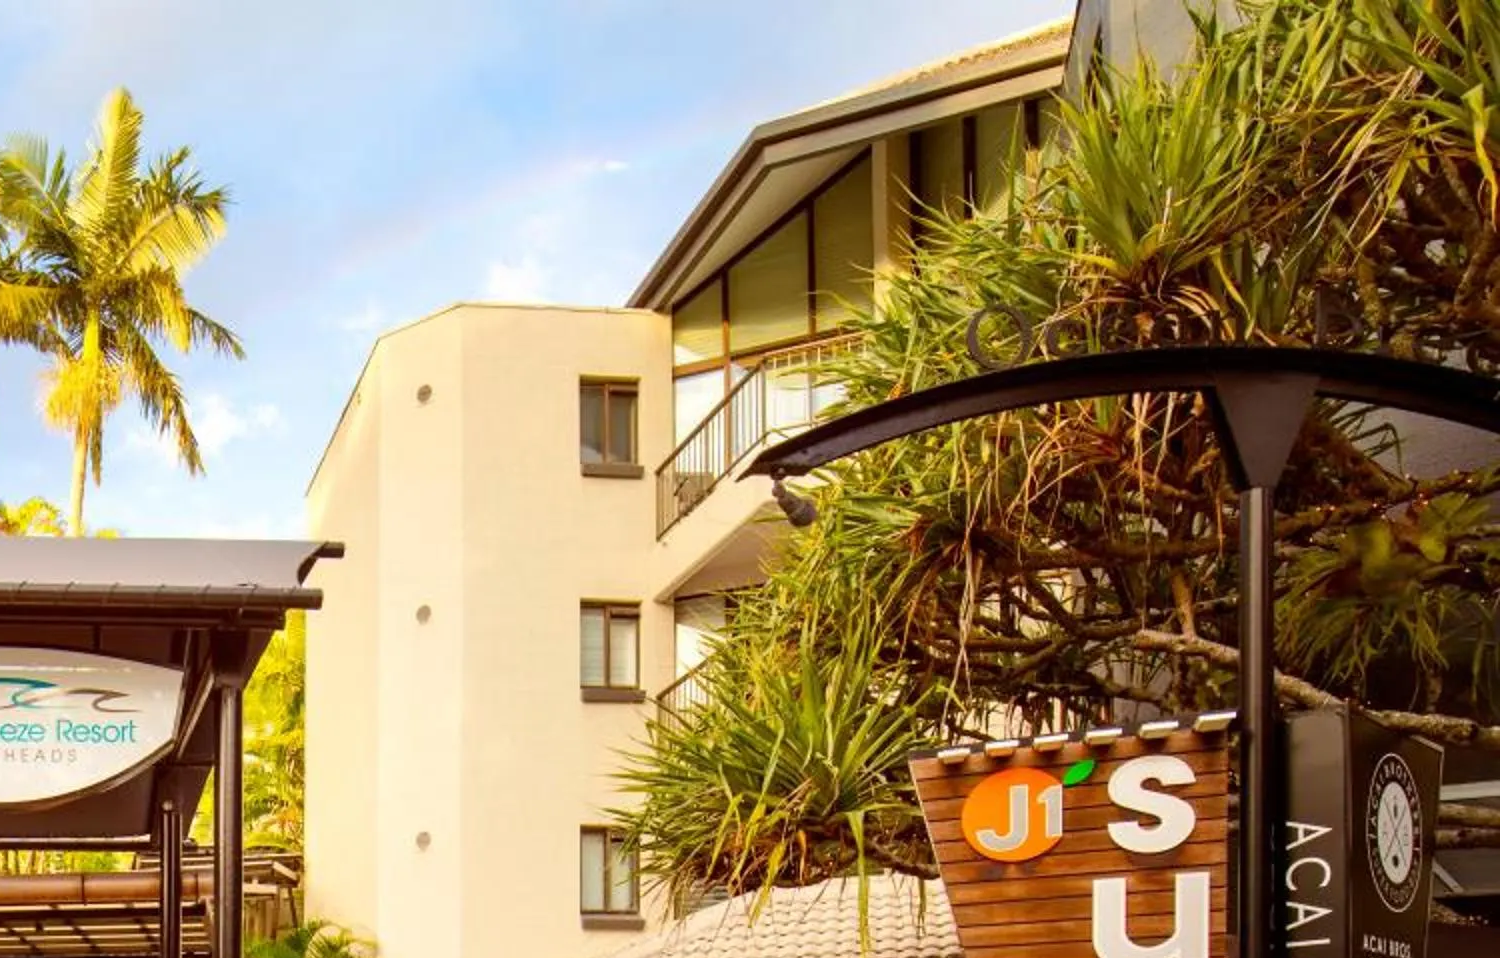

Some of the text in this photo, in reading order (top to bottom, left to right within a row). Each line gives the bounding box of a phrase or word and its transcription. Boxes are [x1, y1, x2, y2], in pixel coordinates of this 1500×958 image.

[56, 718, 139, 744] Resort
[3, 747, 78, 764] HEADS
[1285, 821, 1333, 949] ACAI
[1363, 933, 1387, 956] ACAI
